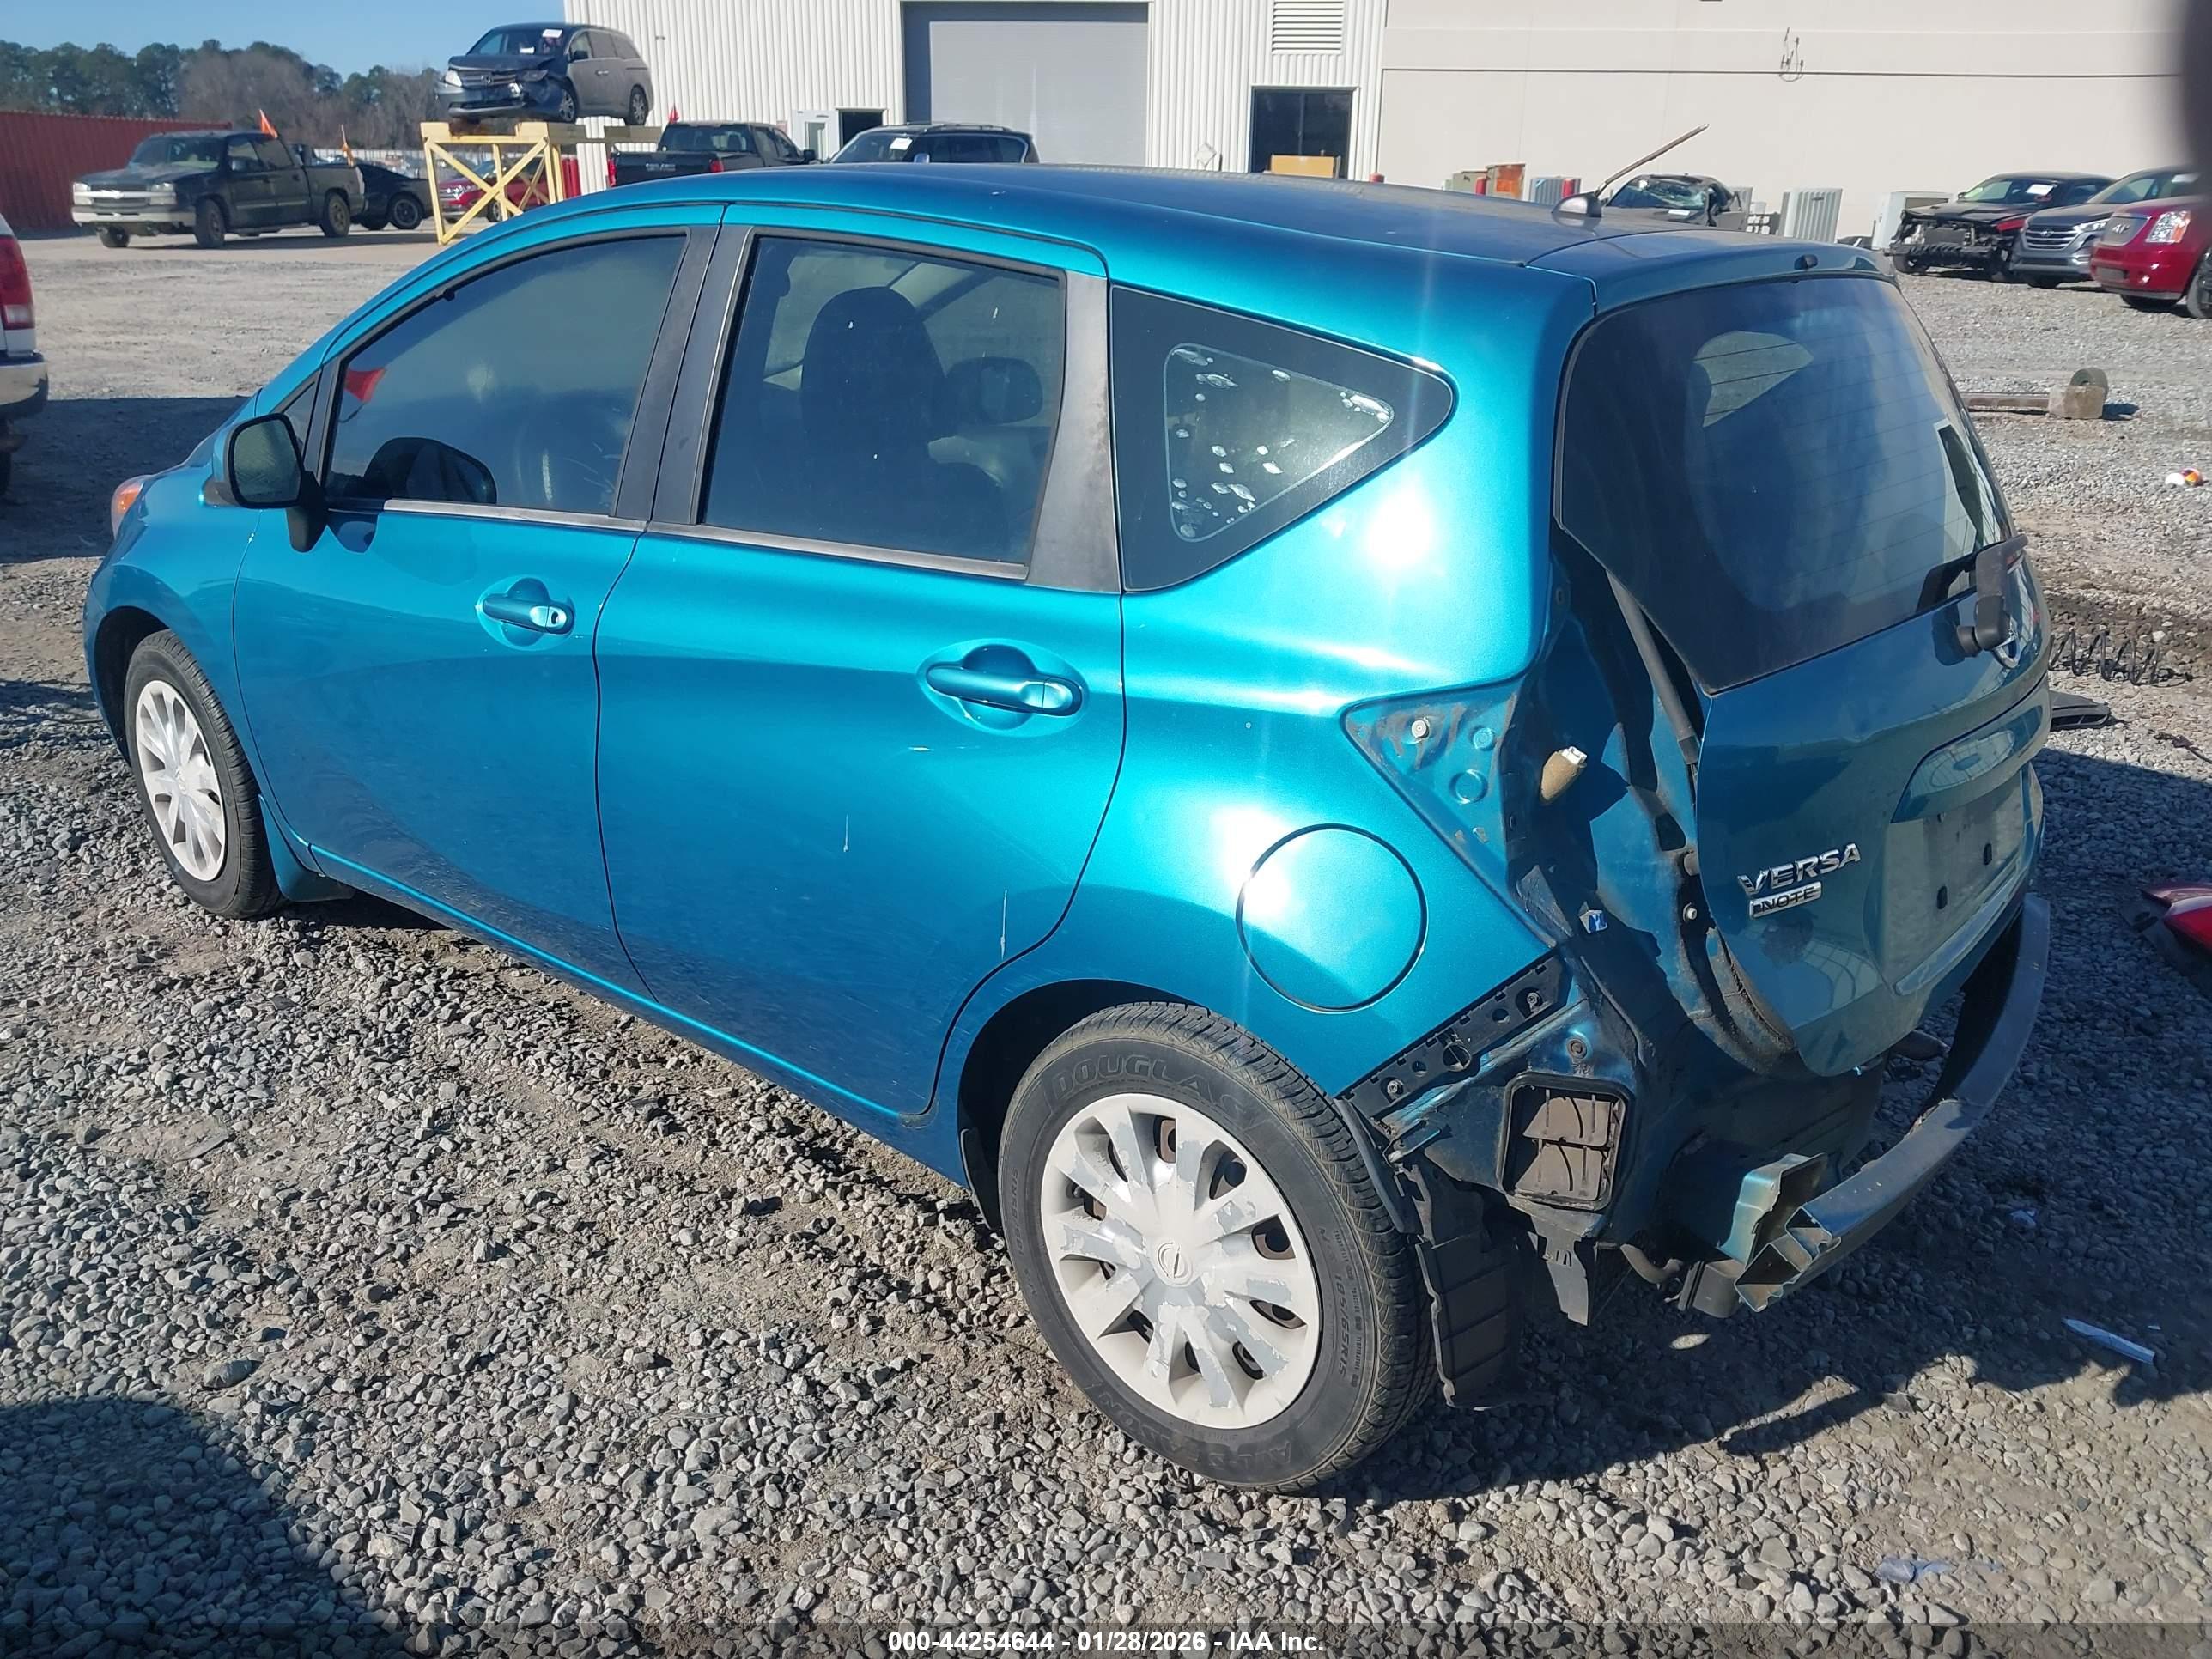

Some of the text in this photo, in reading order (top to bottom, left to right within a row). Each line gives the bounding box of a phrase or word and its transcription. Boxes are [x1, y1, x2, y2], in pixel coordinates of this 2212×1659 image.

[1736, 842, 1862, 898] VERSA
[1753, 884, 1817, 915] NOTE
[1050, 1054, 1251, 1122] DOUGLAS
[1334, 1274, 1351, 1379] 185/65R15
